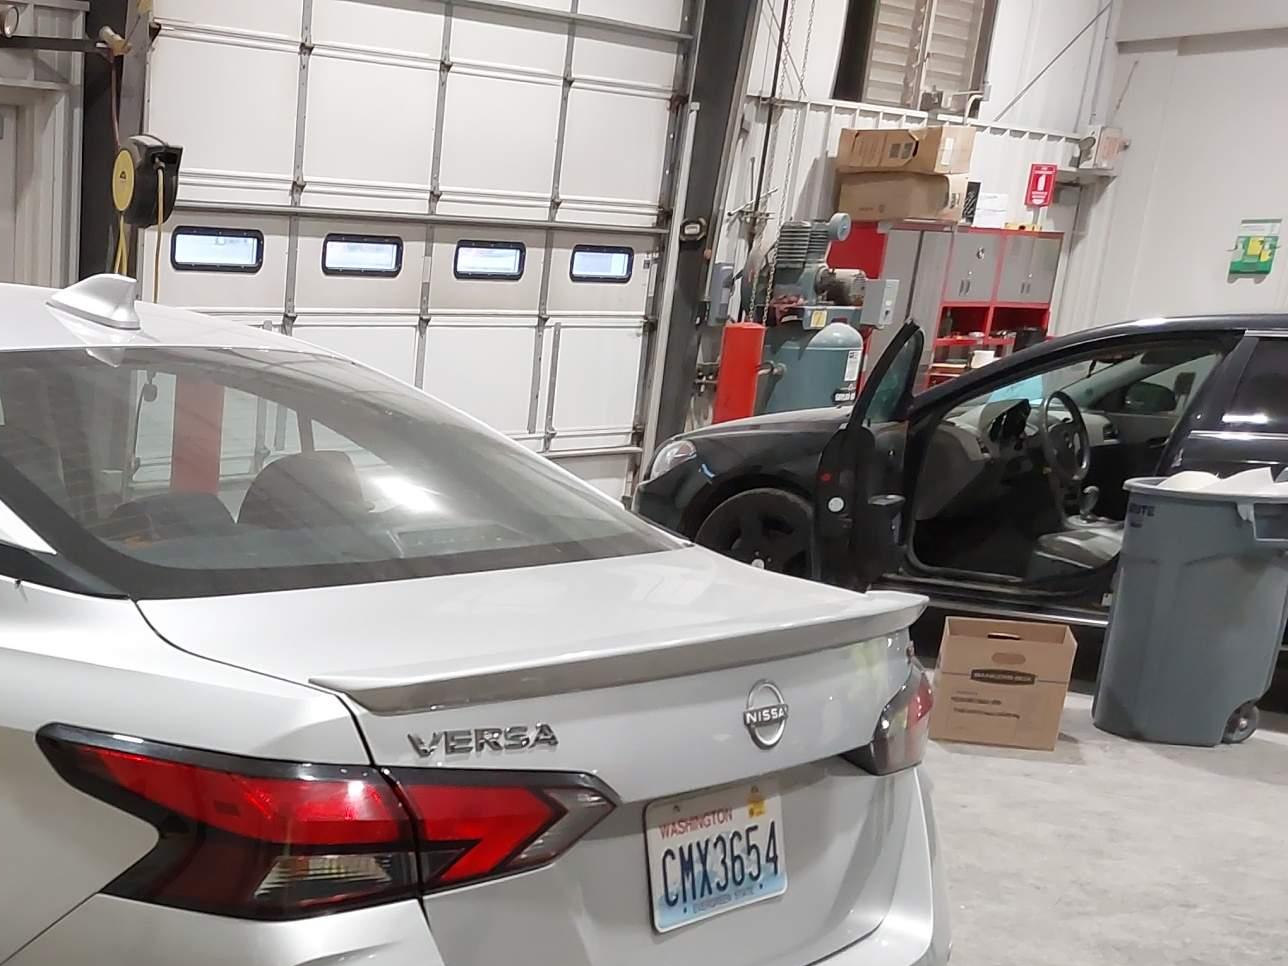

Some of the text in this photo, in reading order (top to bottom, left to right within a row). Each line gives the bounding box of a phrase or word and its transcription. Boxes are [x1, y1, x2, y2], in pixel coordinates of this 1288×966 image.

[407, 724, 559, 758] VERSA
[658, 808, 733, 839] WASHINGTON
[662, 820, 779, 908] CMX3654
